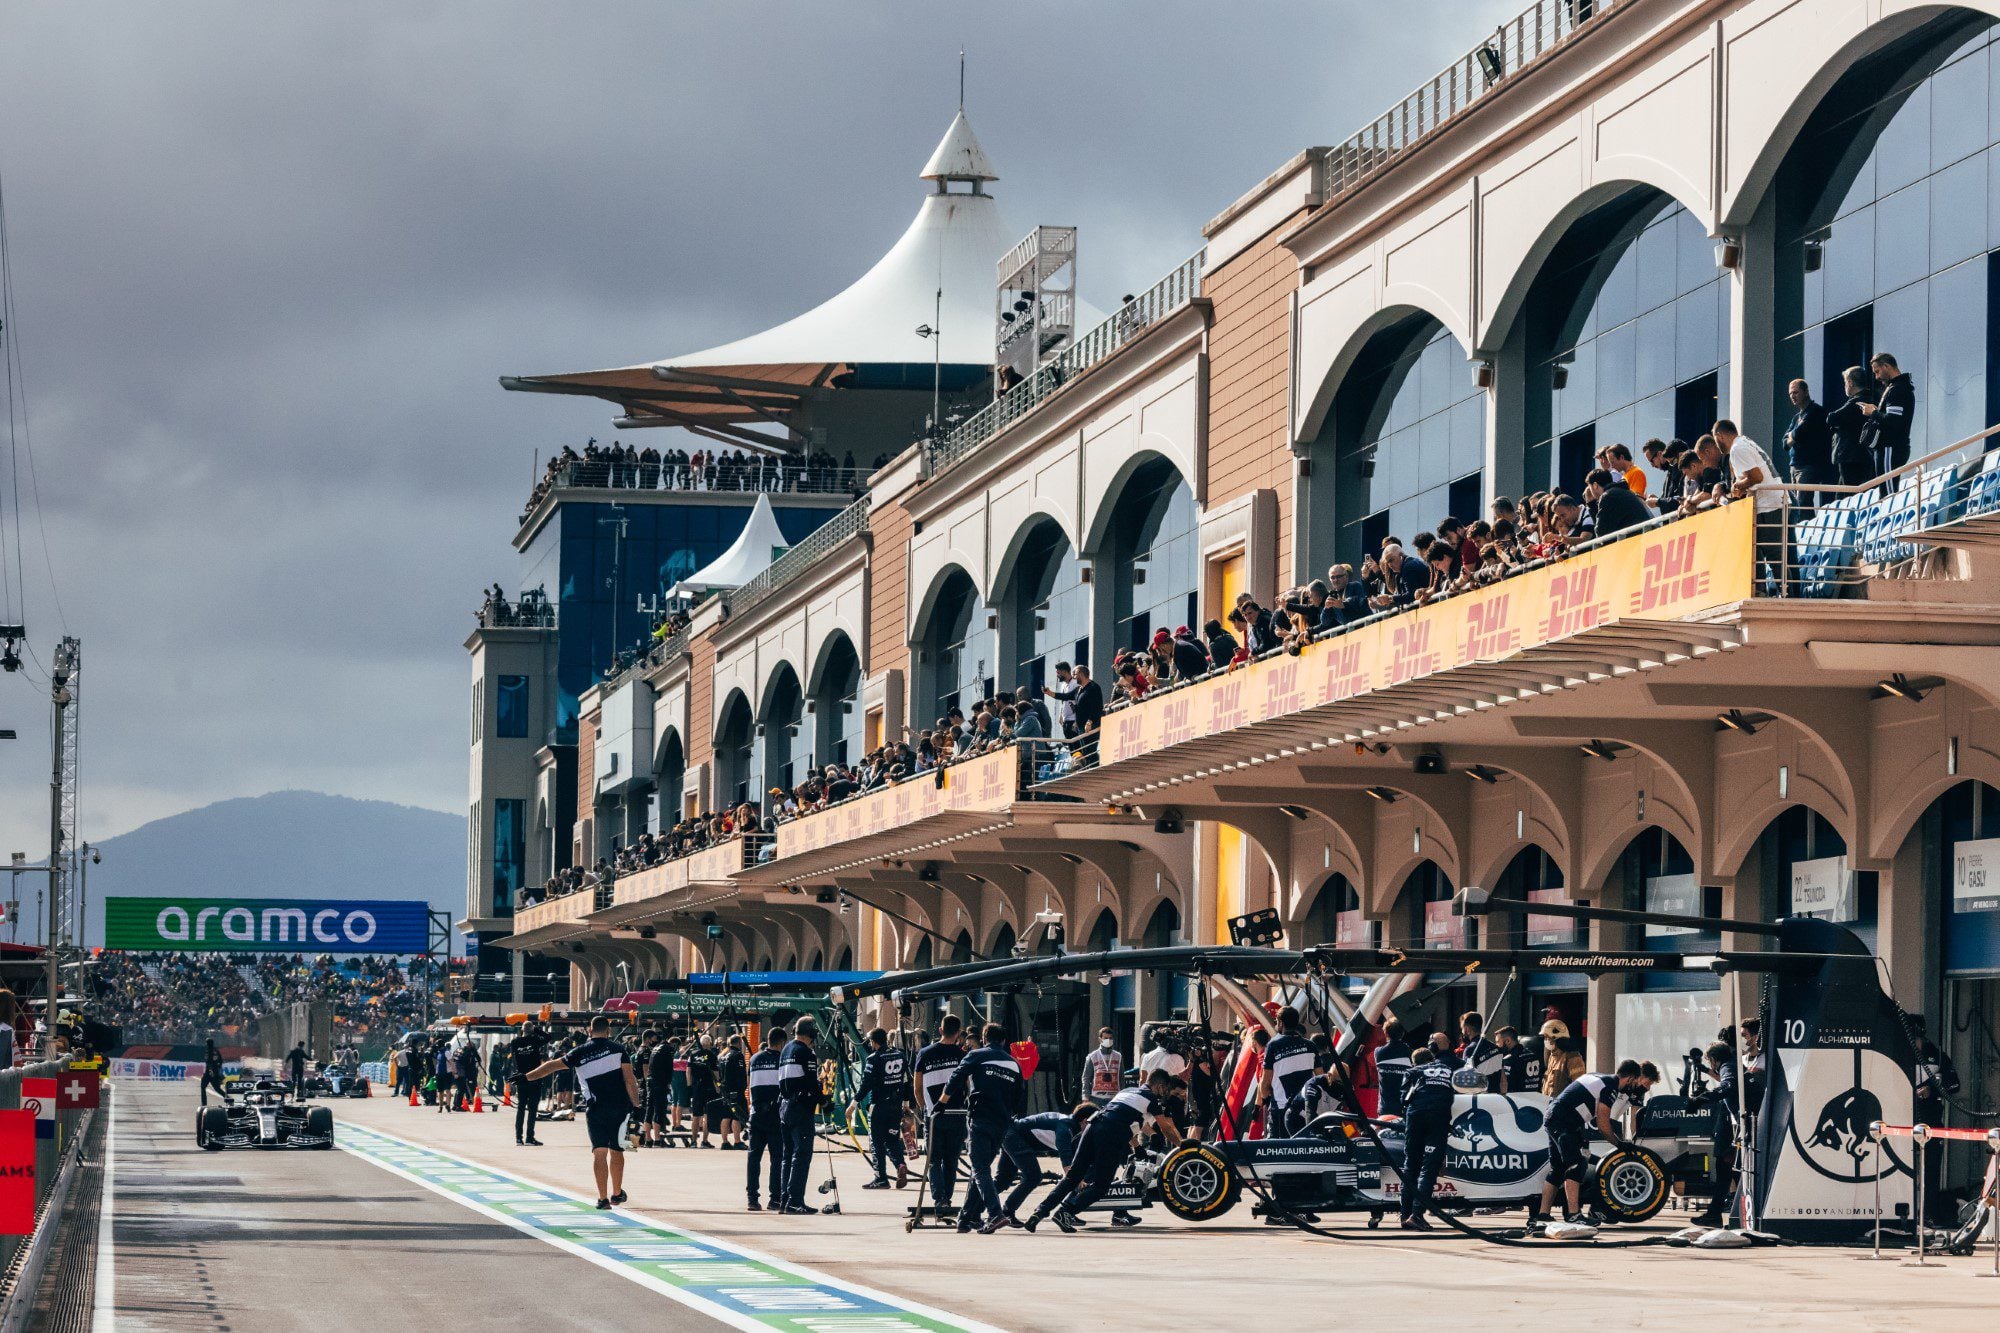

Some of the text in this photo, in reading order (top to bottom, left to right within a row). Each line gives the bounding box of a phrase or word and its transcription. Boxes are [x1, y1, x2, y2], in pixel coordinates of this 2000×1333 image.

[1642, 532, 1700, 611] DHL
[1549, 565, 1600, 638] DHL
[1466, 594, 1512, 661] DHL
[1392, 619, 1433, 682] DHL
[1267, 662, 1300, 718] DHL
[1326, 642, 1363, 702] DHL
[1164, 699, 1192, 747] DHL
[1212, 681, 1242, 732] DHL
[1118, 714, 1144, 760] DHL
[950, 771, 969, 808] DHL
[983, 761, 1001, 800] DHL
[1957, 857, 1966, 886] 10
[1969, 870, 1987, 888] GASLY
[156, 906, 377, 944] aramco
[1539, 955, 1654, 967] alphataurif1team.com
[1784, 1019, 1805, 1044] 10
[1818, 1036, 1871, 1044] ALPHATAURI
[159, 1064, 187, 1078] BWT
[1200, 1148, 1226, 1170] PIRELLI
[1256, 1145, 1346, 1156] ALPHATAURI.FASHION
[1446, 1154, 1528, 1169] HATAURI
[1642, 1153, 1664, 1180] PIRELLI
[1107, 1187, 1136, 1196] TAURI
